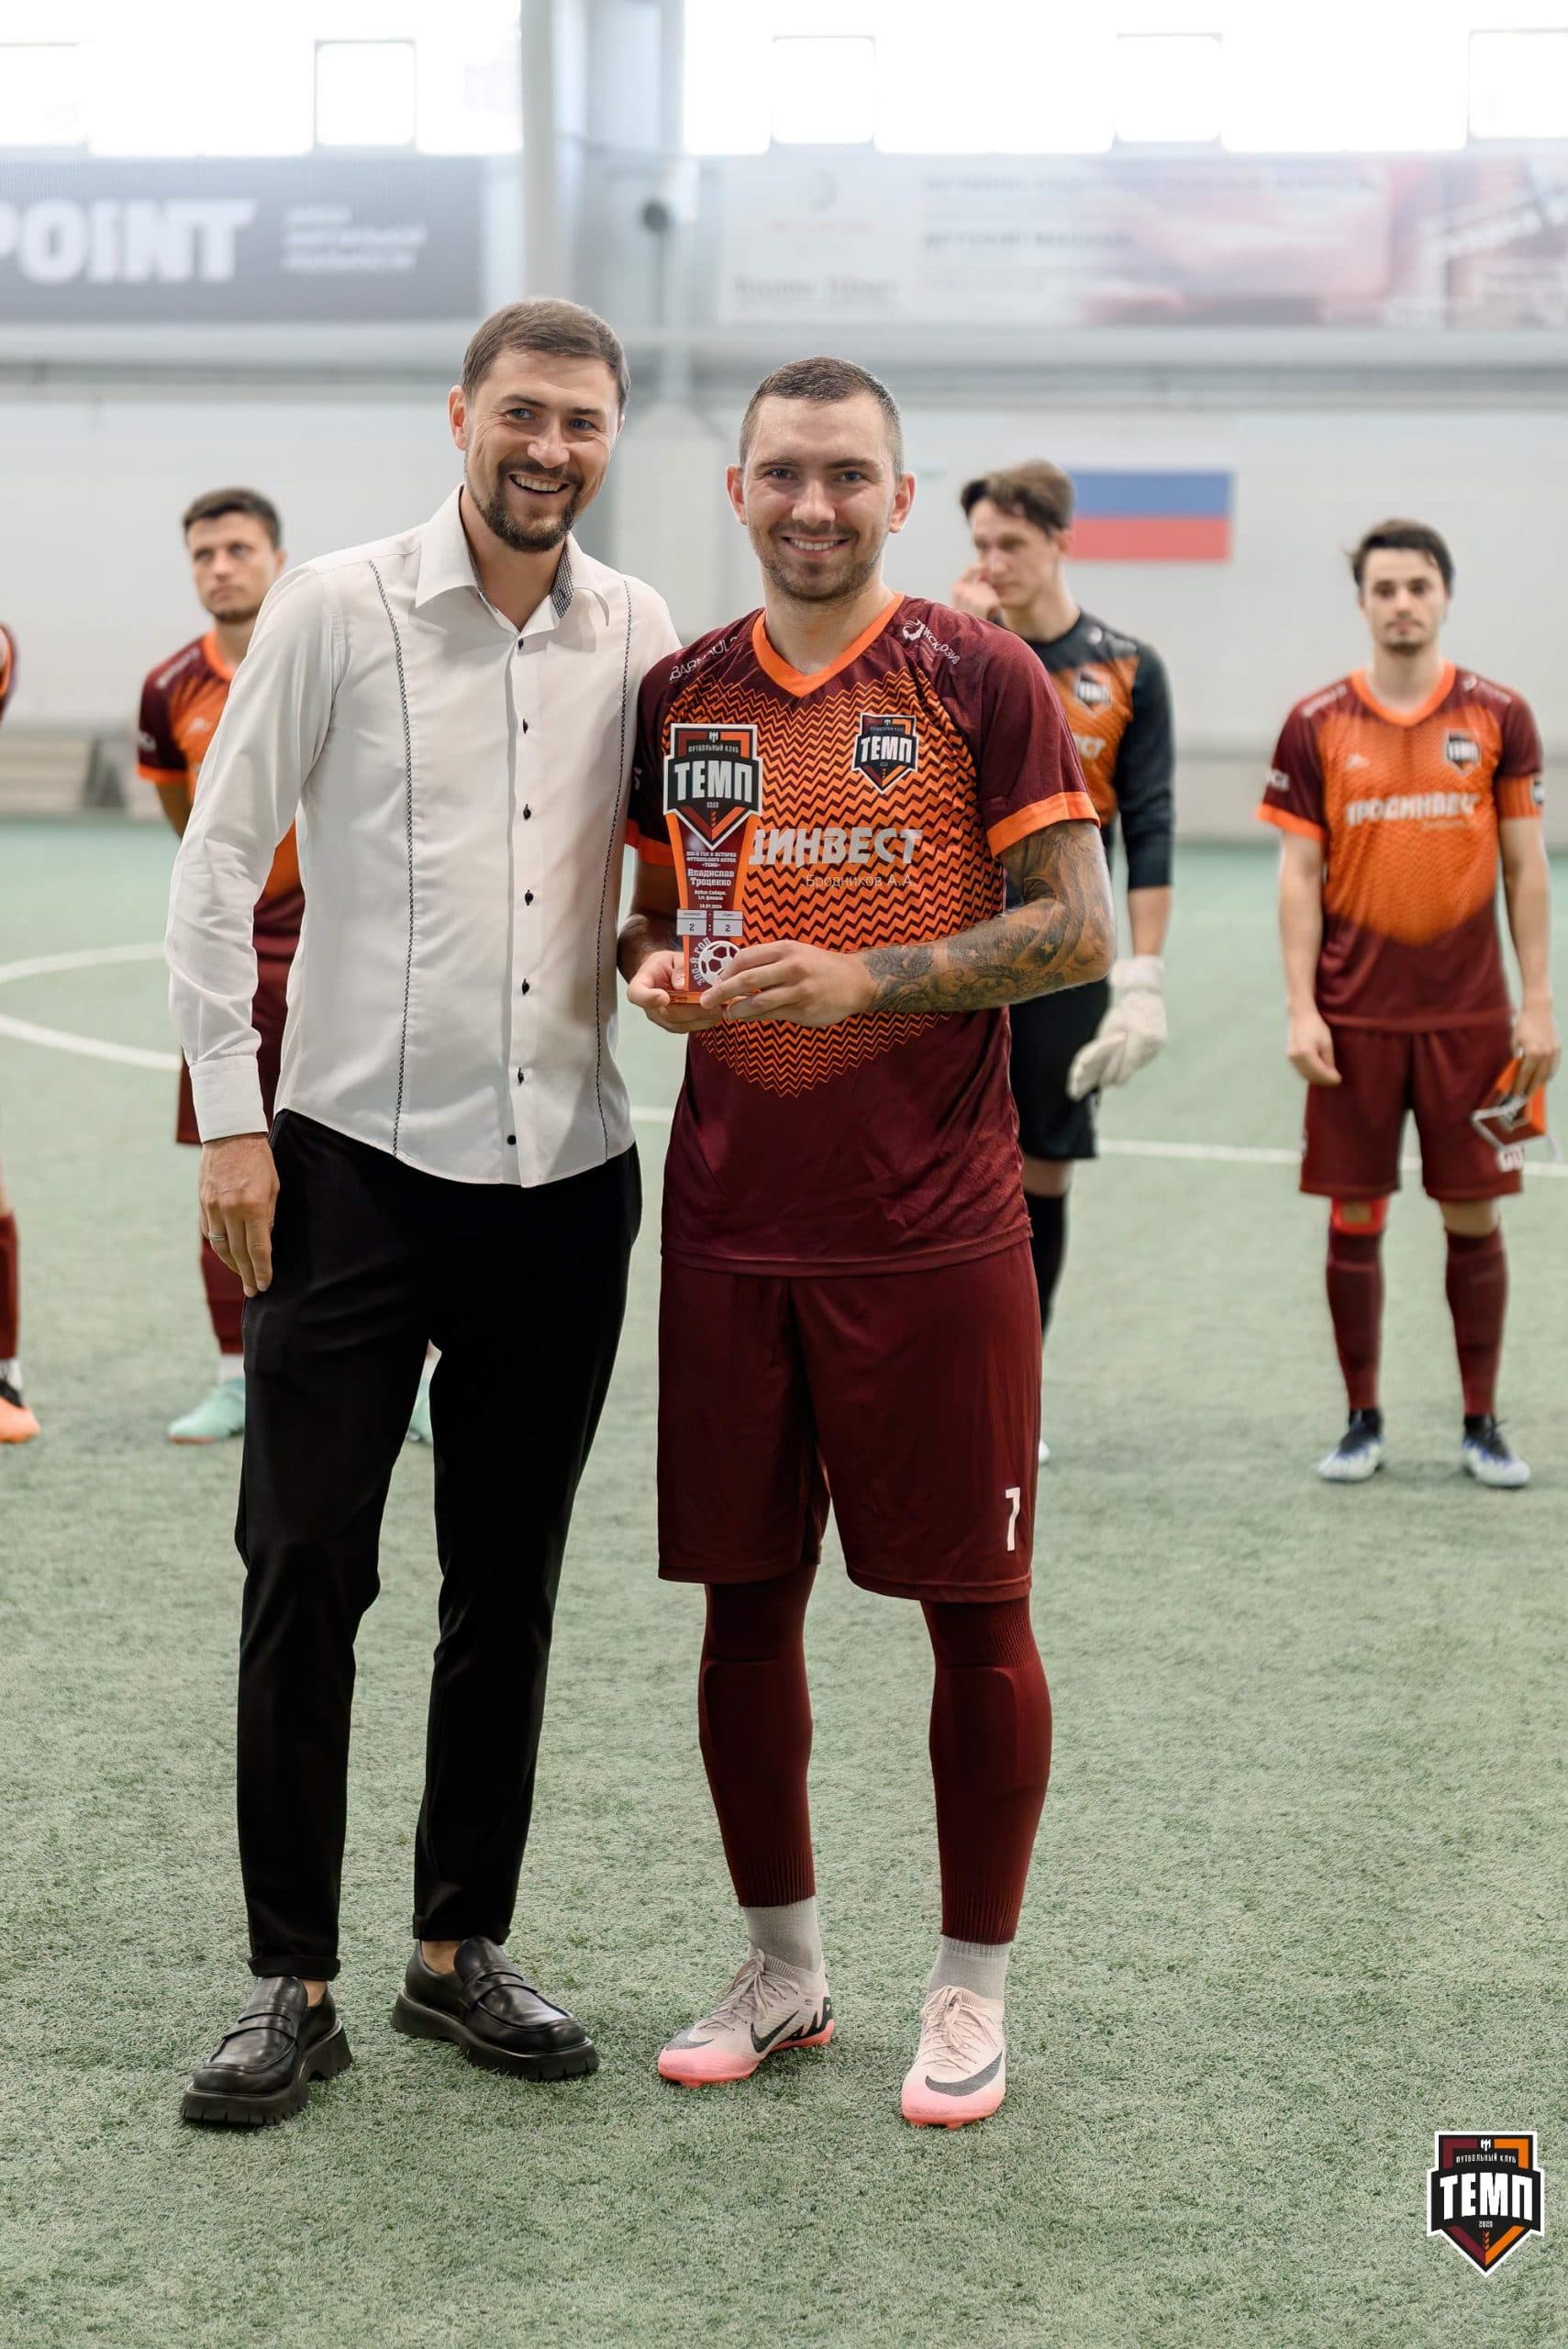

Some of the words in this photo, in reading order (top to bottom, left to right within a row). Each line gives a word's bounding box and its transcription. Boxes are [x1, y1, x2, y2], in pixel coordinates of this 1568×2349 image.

[861, 735, 913, 763] ТЕМП
[674, 761, 752, 803] ТЕМП
[687, 868, 735, 878] Владислав
[690, 877, 732, 887] Троценко
[806, 874, 882, 890] Бродников
[689, 923, 695, 931] 2
[725, 924, 731, 932] 2
[1006, 1486, 1020, 1552] 7
